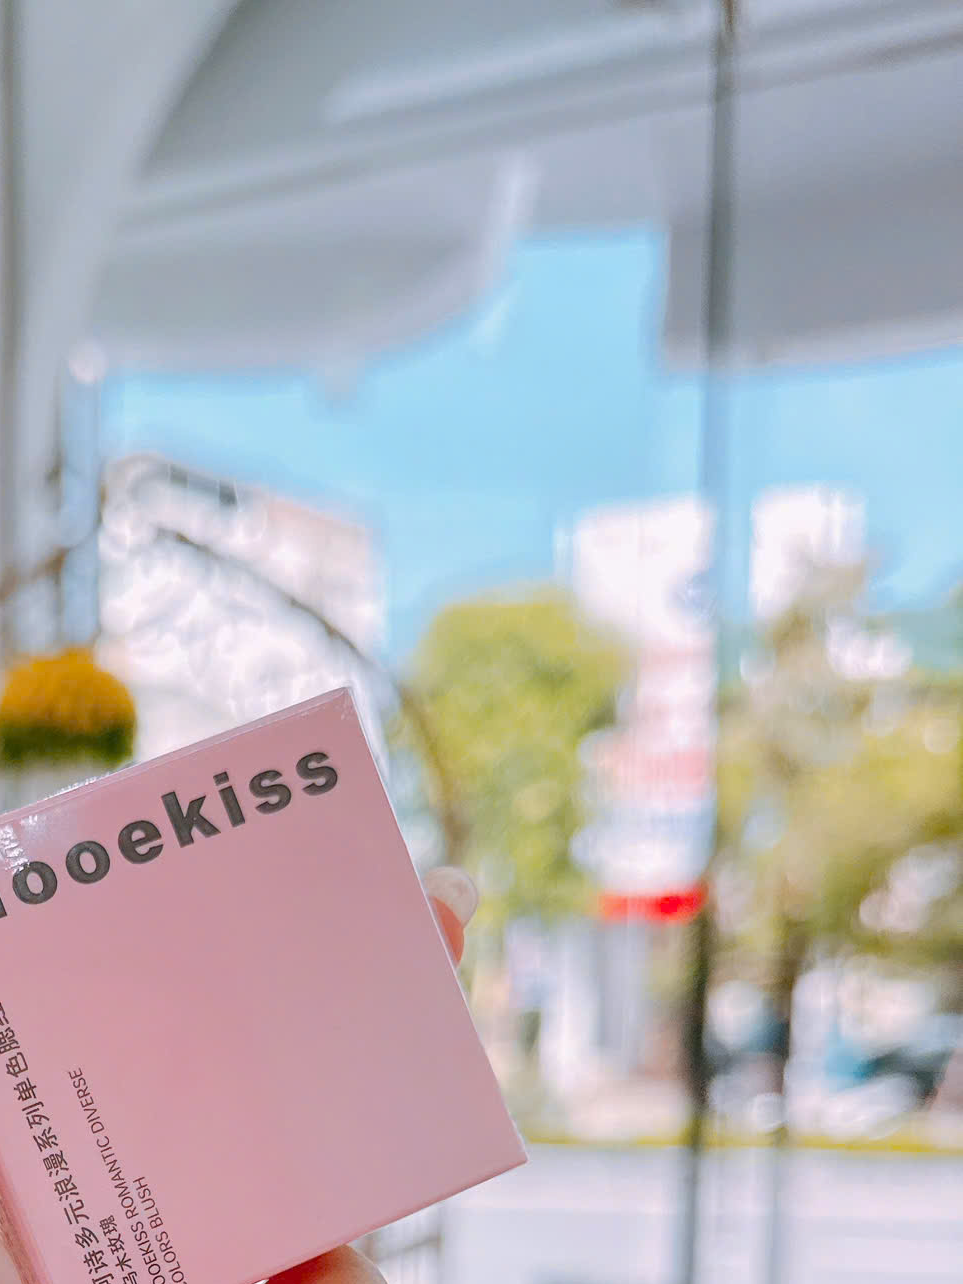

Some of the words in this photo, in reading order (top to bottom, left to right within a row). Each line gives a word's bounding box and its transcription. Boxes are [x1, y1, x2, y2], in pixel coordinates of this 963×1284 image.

[67, 1067, 105, 1135] DIVERSE
[95, 1135, 140, 1220] ROMANTIC
[132, 1176, 164, 1230] BLUSH
